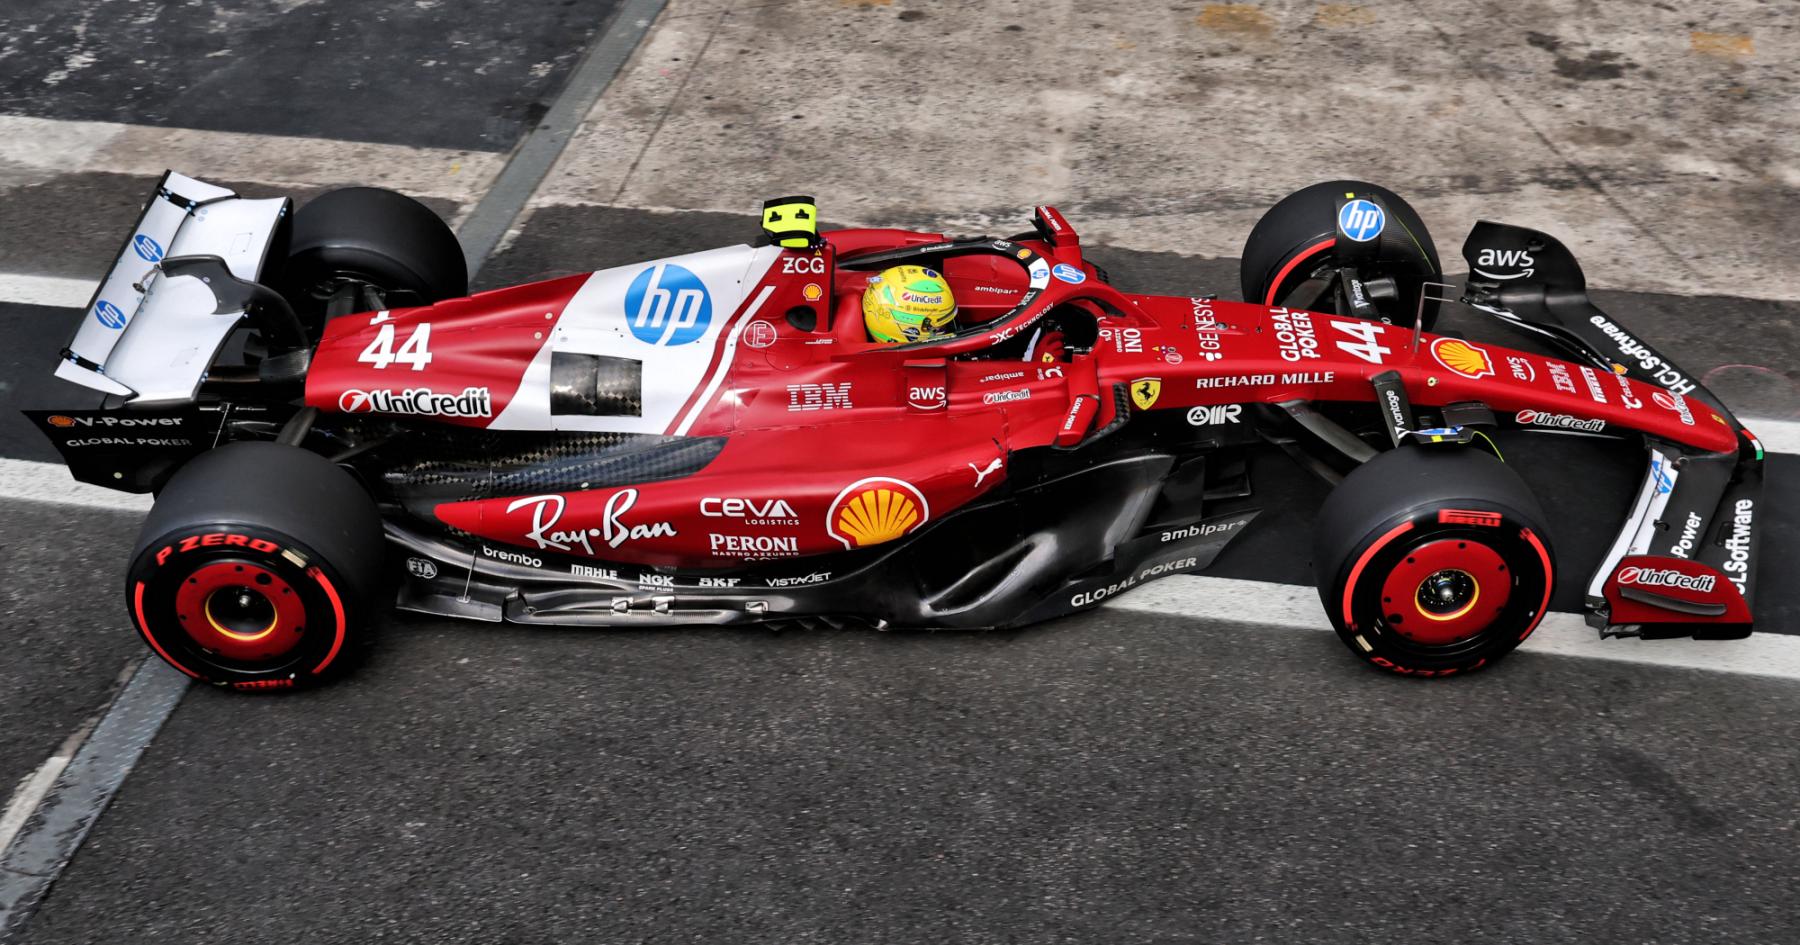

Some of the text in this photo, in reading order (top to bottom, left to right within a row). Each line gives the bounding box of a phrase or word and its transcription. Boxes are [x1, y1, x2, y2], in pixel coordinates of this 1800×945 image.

[1343, 200, 1380, 241] hp
[134, 235, 162, 262] hp
[1477, 249, 1534, 267] aws
[911, 293, 942, 304] UniCredit
[974, 286, 1014, 295] ambipar
[95, 301, 126, 329] hp
[628, 264, 708, 346] hp
[989, 327, 1014, 346] DXC
[1014, 302, 1054, 333] TECHNOLOGY
[1191, 297, 1220, 351] GENESYS
[1269, 307, 1301, 362] GLOBAL
[1291, 312, 1321, 359] POKER
[357, 322, 433, 371] 44
[1122, 328, 1143, 353] ONI
[1329, 319, 1392, 365] 44
[1590, 315, 1696, 396] HCLSoftware
[1196, 371, 1335, 389] RICHARD MILLE
[1506, 356, 1527, 381] aws
[370, 388, 490, 416] UniCredit
[786, 382, 853, 411] IBM
[909, 387, 946, 400] aws
[994, 388, 1030, 403] UniCredit
[74, 416, 184, 427] V-Power
[1535, 411, 1605, 432] UniCredit
[66, 437, 192, 447] GLOBAL POKER
[709, 533, 798, 552] PERONI
[1161, 520, 1236, 543] ambipar
[1670, 511, 1702, 558] Power
[155, 533, 279, 566] P ZERO
[483, 545, 543, 568] brembo
[1723, 499, 1753, 594] LSoftware
[571, 564, 618, 580] MAHLE
[639, 574, 674, 587] NGK
[698, 577, 741, 587] SKF
[1070, 556, 1197, 607] GLOBAL POKER
[1638, 568, 1715, 592] UniCredit
